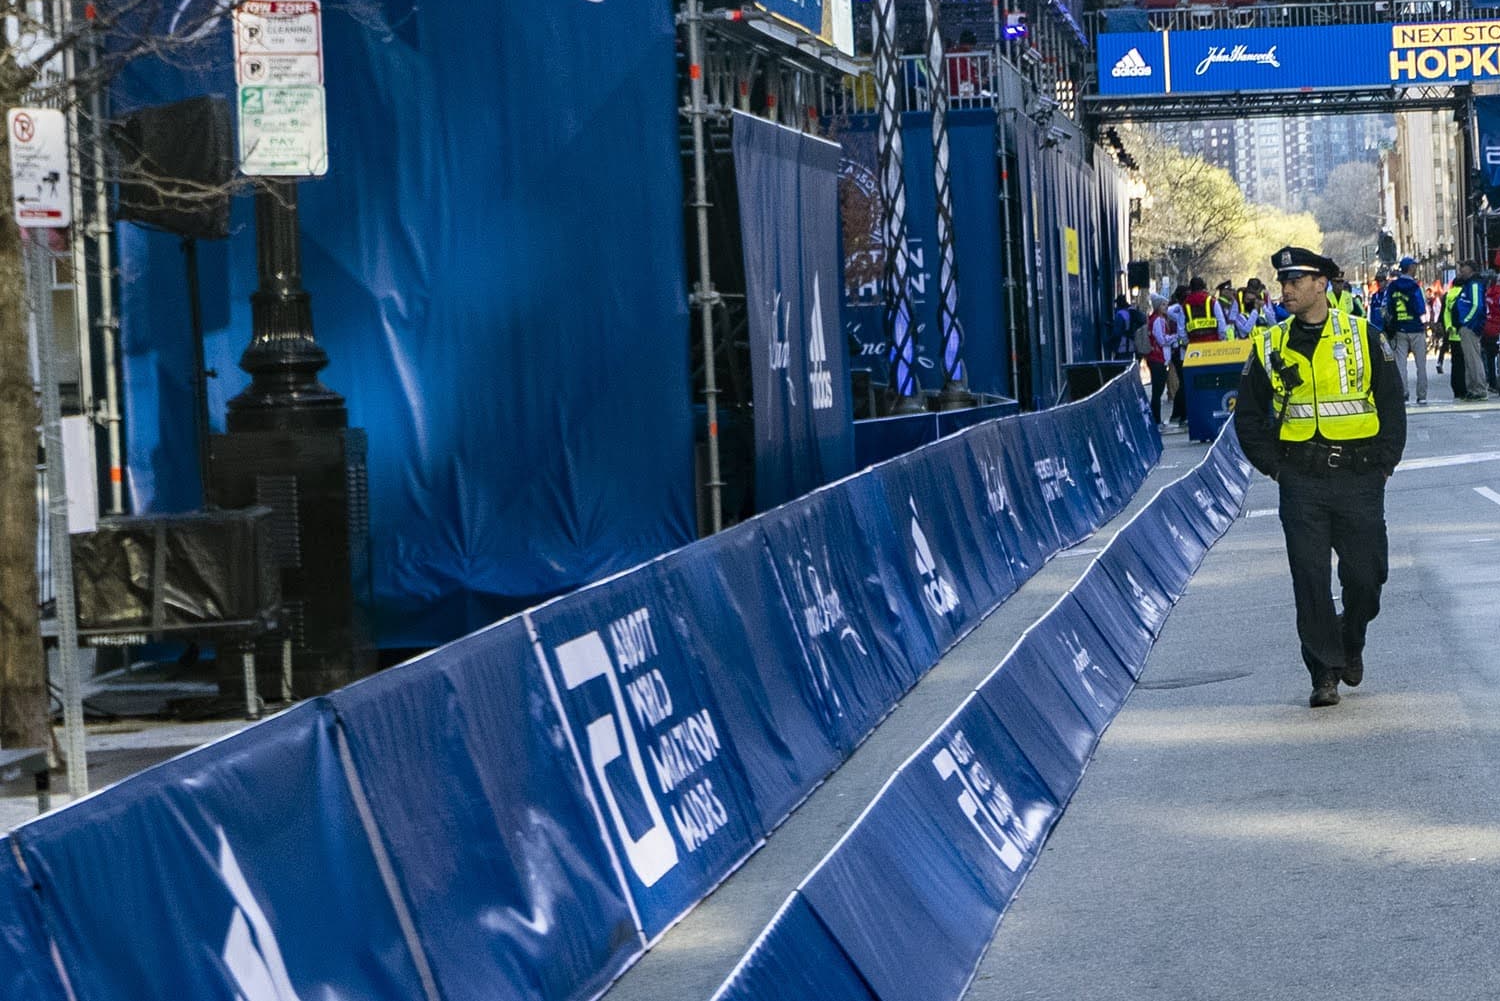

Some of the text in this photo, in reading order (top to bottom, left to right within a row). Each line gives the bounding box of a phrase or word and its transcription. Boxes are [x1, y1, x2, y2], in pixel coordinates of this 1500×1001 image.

[278, 3, 313, 14] ZONE
[1401, 27, 1457, 44] NEXT
[1195, 44, 1281, 75] John Hancock
[1111, 65, 1152, 77] adidas
[1343, 327, 1356, 388] POLICE
